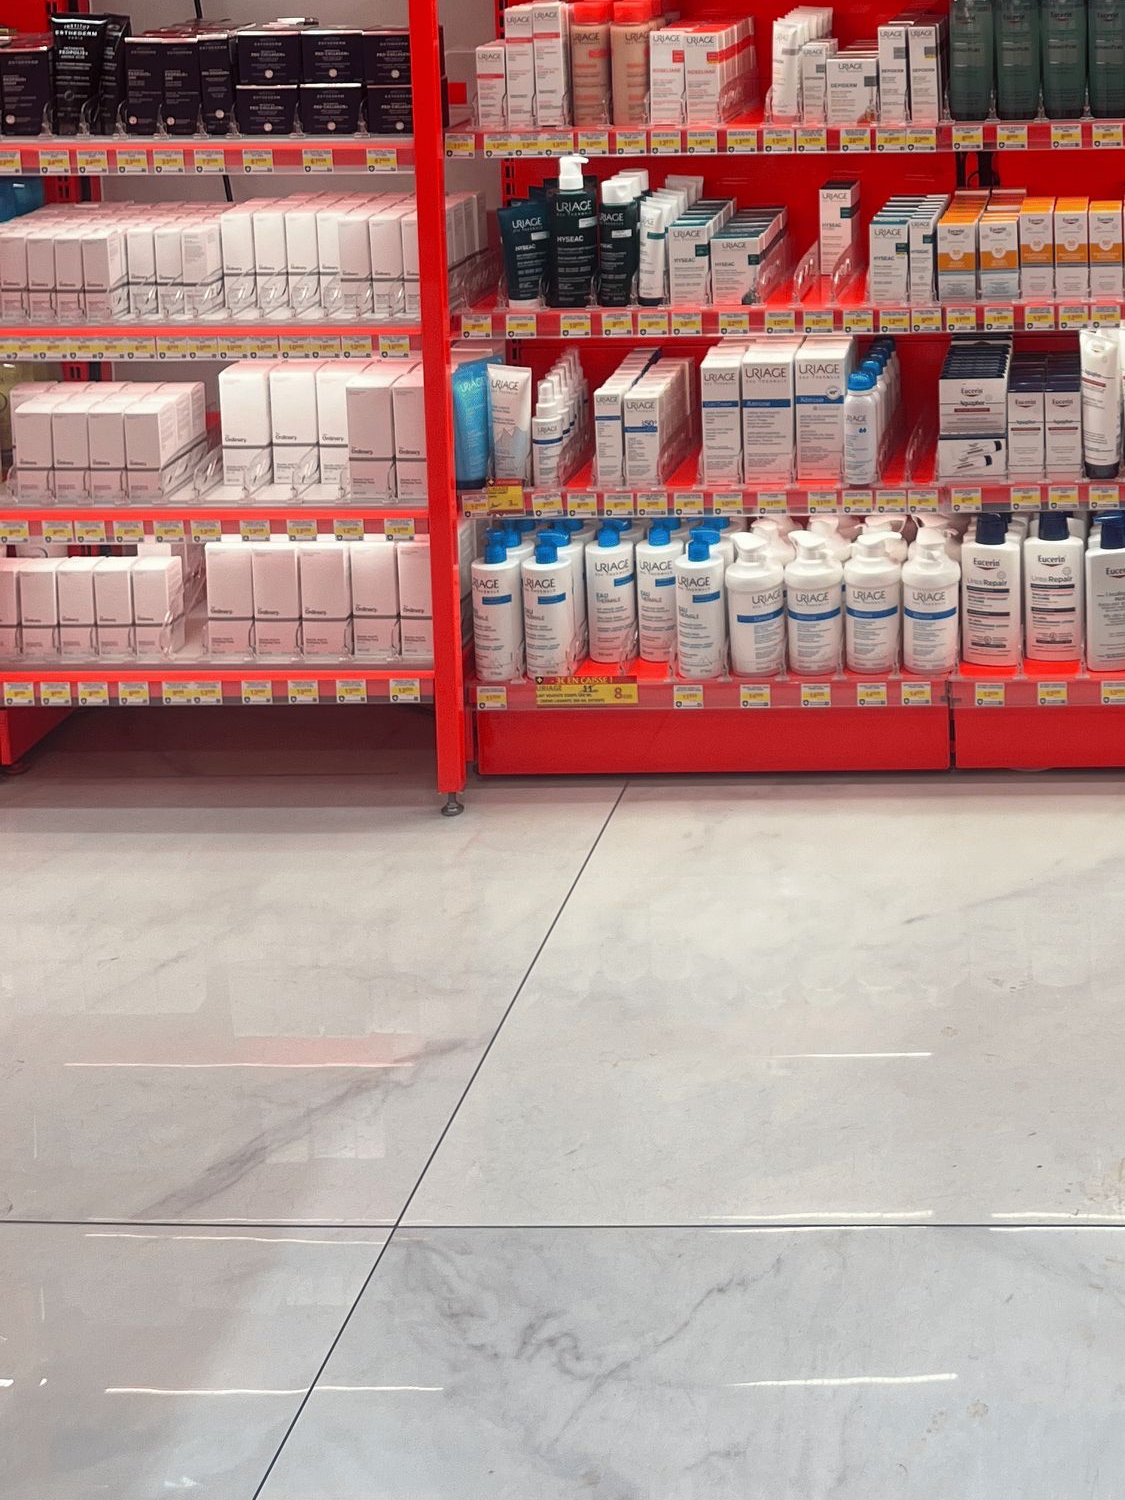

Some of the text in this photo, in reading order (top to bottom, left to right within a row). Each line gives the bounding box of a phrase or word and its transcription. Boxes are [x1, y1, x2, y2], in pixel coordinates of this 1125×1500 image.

[506, 15, 531, 25] URIAGE
[534, 11, 557, 21] URIAGE
[652, 34, 680, 44] URIAGE
[880, 30, 903, 39] URIAGE
[910, 29, 933, 39] URIAGE
[686, 36, 714, 45] URIAGE
[838, 62, 863, 71] URIAGE
[822, 192, 848, 201] URIAGE
[556, 200, 593, 213] URIAGE
[511, 216, 542, 228] URIAGE
[673, 230, 701, 240] URIAGE
[874, 228, 902, 239] URIAGE
[722, 241, 747, 249] URIAGE
[745, 367, 787, 379] URIAGE
[799, 363, 840, 375] URIAGE
[704, 373, 735, 382] URIAGE
[491, 379, 519, 392] URIAGE
[626, 401, 655, 410] URIAGE
[973, 558, 1000, 567] Eucerin
[1038, 555, 1065, 564] Eucerin
[595, 560, 630, 573] URIAGE
[639, 560, 672, 572] URIAGE
[677, 576, 710, 588] URIAGE
[751, 590, 782, 604] URIAGE
[795, 592, 829, 604] URIAGE
[852, 590, 886, 602] URIAGE
[912, 591, 945, 603] URIAGE
[576, 676, 606, 684] CAISSE
